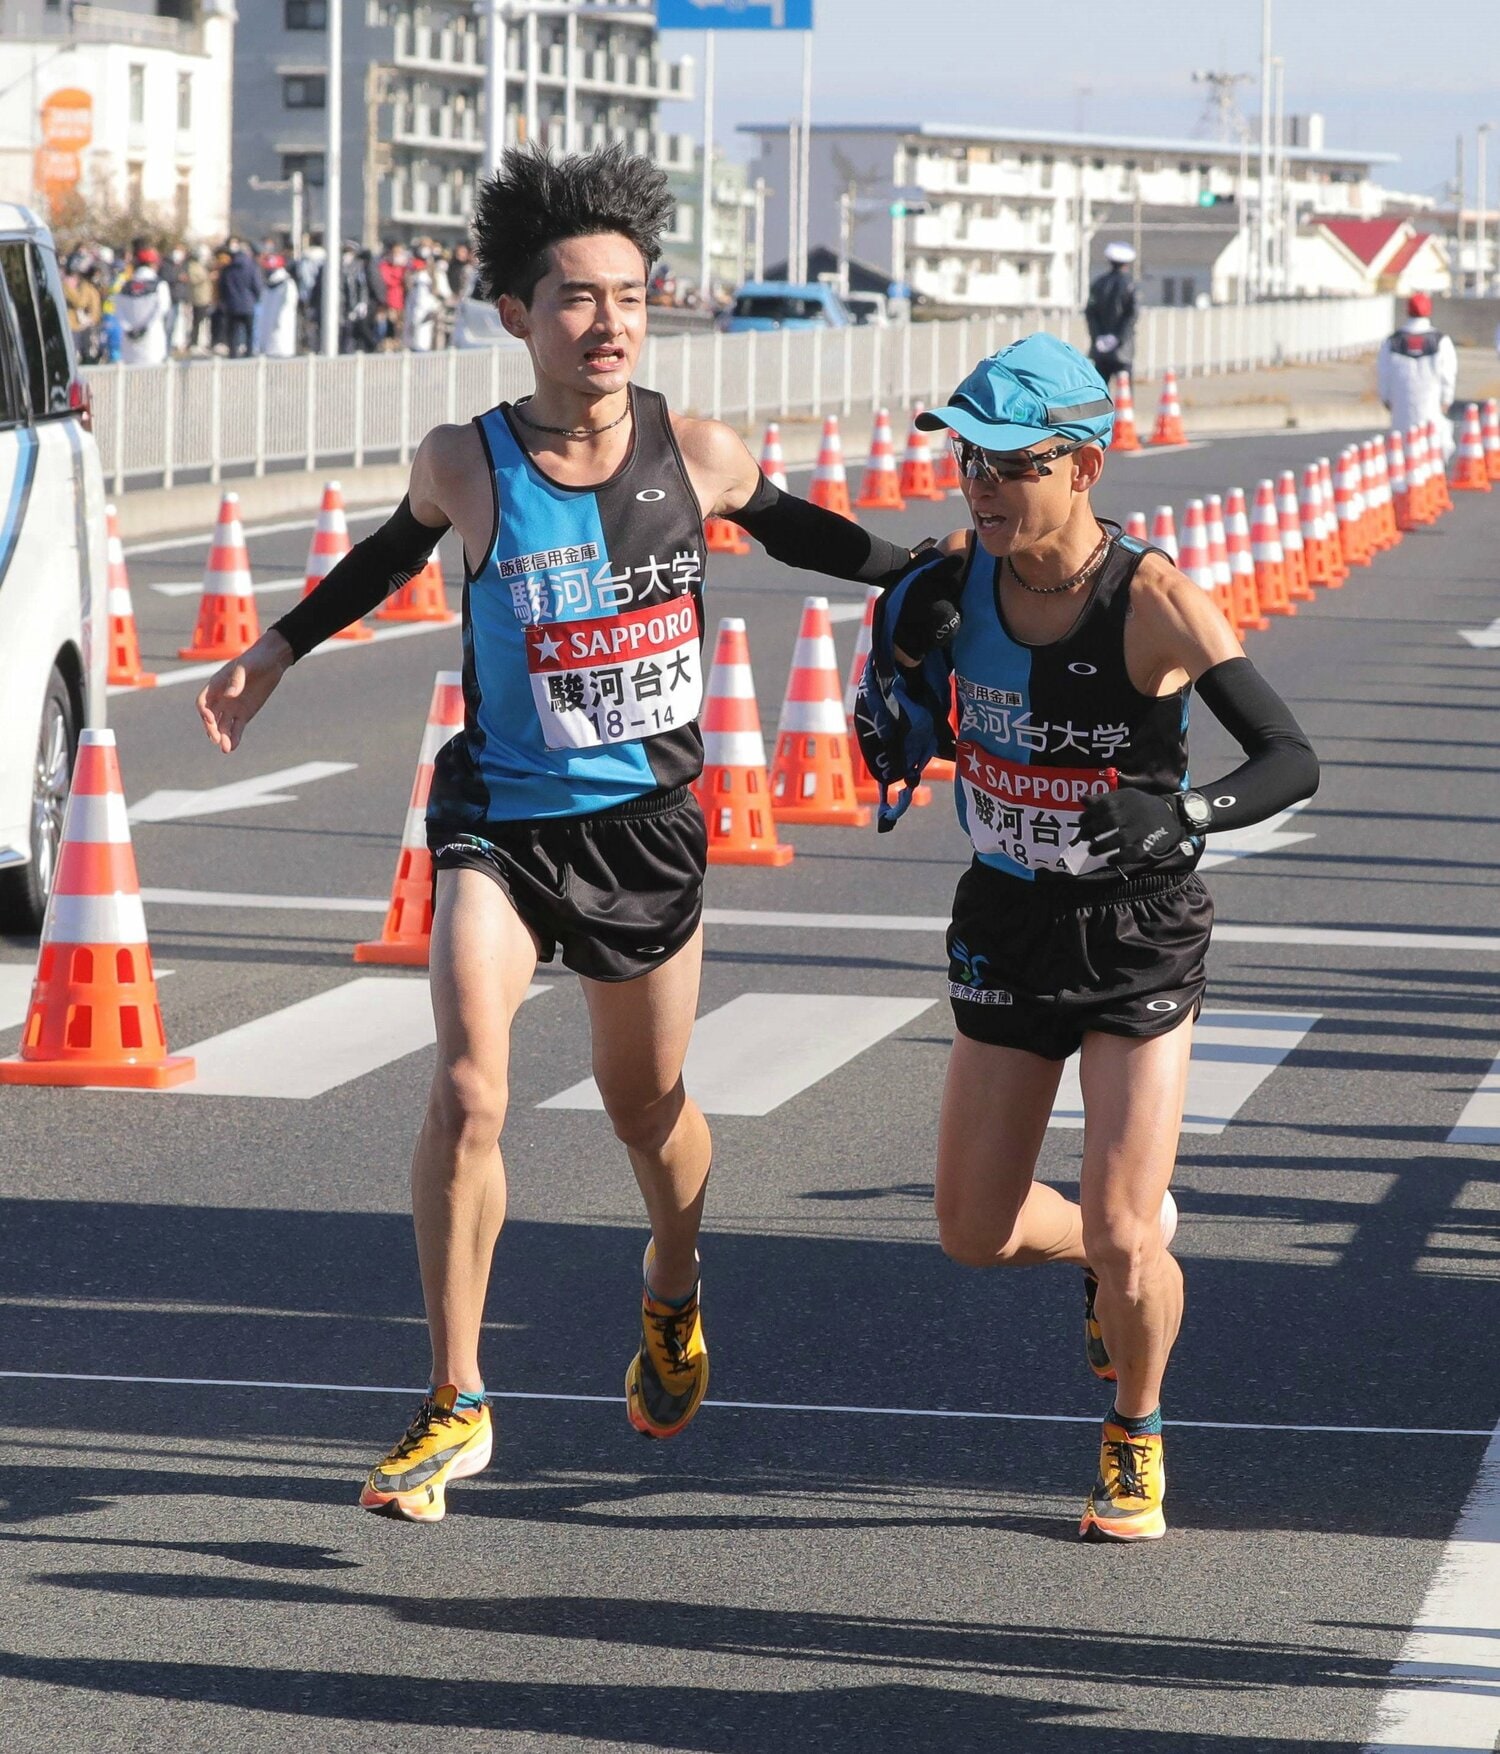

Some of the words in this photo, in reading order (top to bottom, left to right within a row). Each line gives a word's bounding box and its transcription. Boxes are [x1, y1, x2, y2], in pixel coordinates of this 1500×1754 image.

[500, 544, 598, 577] 飯能信用金庫
[509, 550, 701, 624] 駿河台大学
[570, 607, 692, 660] SAPPORO
[547, 650, 691, 713] 駿河台大
[590, 706, 674, 740] 18-14
[985, 764, 1110, 803] SAPPORO
[949, 982, 1012, 1005] 能信用金庫
